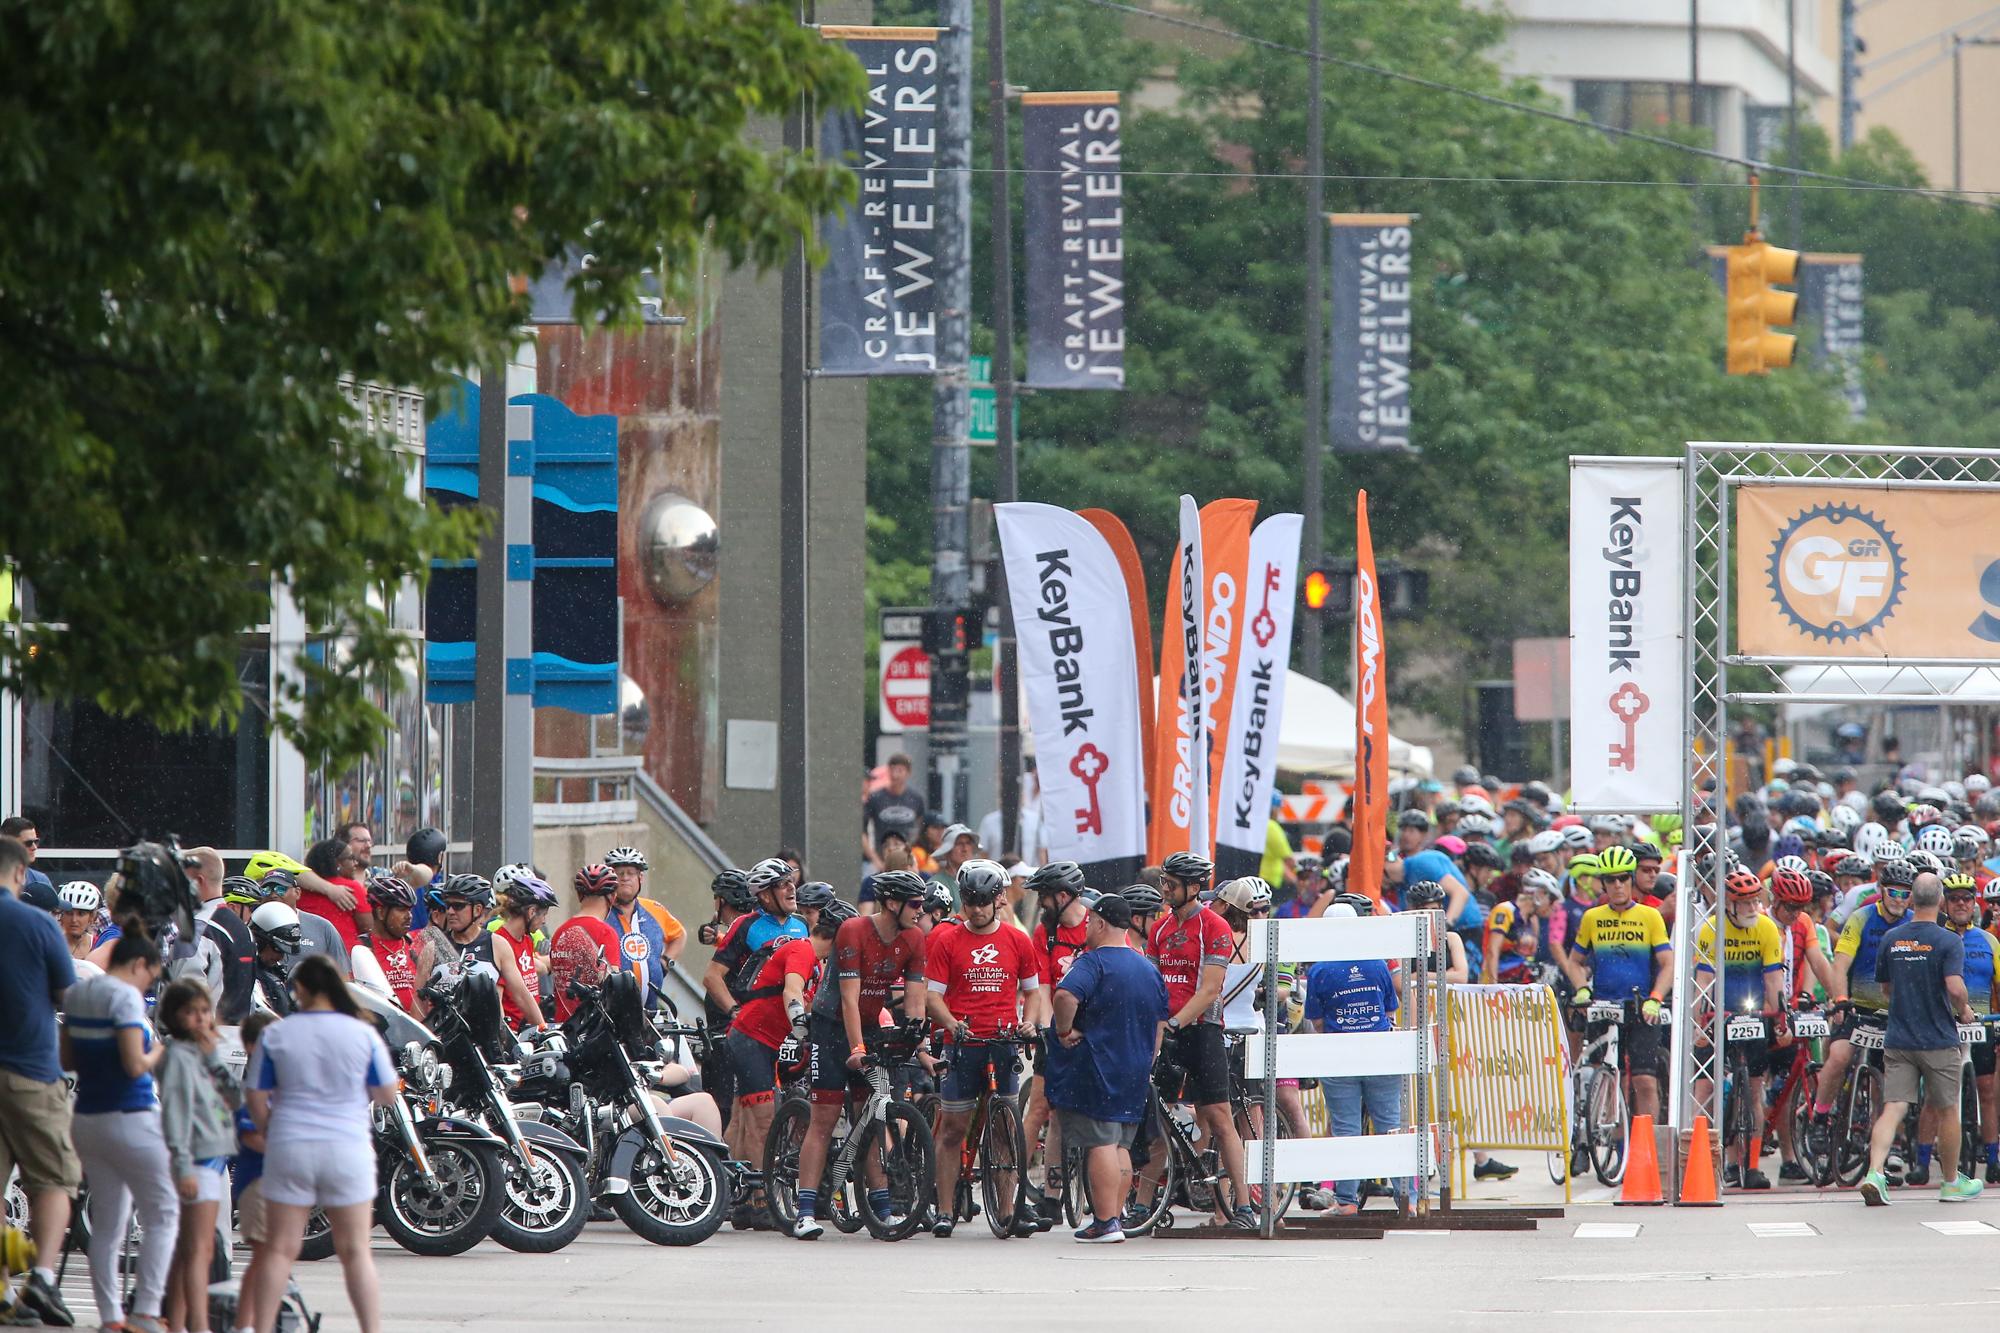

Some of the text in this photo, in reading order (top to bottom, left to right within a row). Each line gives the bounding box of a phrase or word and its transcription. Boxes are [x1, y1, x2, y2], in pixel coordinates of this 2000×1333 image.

[864, 63, 887, 358] CRAFT-REVIVAL
[893, 46, 937, 370] JEWELERS
[1059, 122, 1085, 371] CRAFT-REVIVAL
[1084, 107, 1125, 384] JEWELERS
[1358, 238, 1378, 442] CRAFT-REVIVAL
[1378, 227, 1411, 451] JEWELERS
[1848, 538, 1881, 557] GR
[1785, 535, 1889, 616] GF
[1602, 497, 1642, 674] KeyBank
[1035, 548, 1095, 738] KeyBank
[1184, 543, 1201, 743] KeyBank
[915, 661, 930, 676] NO
[895, 699, 928, 714] ENTE
[1235, 659, 1273, 829] KeyBank
[1596, 919, 1619, 928] RIDE
[1597, 931, 1644, 942] MISSION
[1724, 938, 1740, 948] IDE
[1160, 959, 1196, 967] RIUMPH
[1724, 951, 1761, 961] ISSION
[1162, 974, 1189, 983] NGEL
[1338, 985, 1377, 996] VOLUNTEER
[1336, 1005, 1381, 1016] SHARPE
[1731, 1026, 1761, 1039] 2257
[1799, 1023, 1826, 1036] 2128
[1855, 1033, 1883, 1048] 2116
[811, 1043, 820, 1083] ANGEL
[520, 1065, 541, 1077] OLICE
